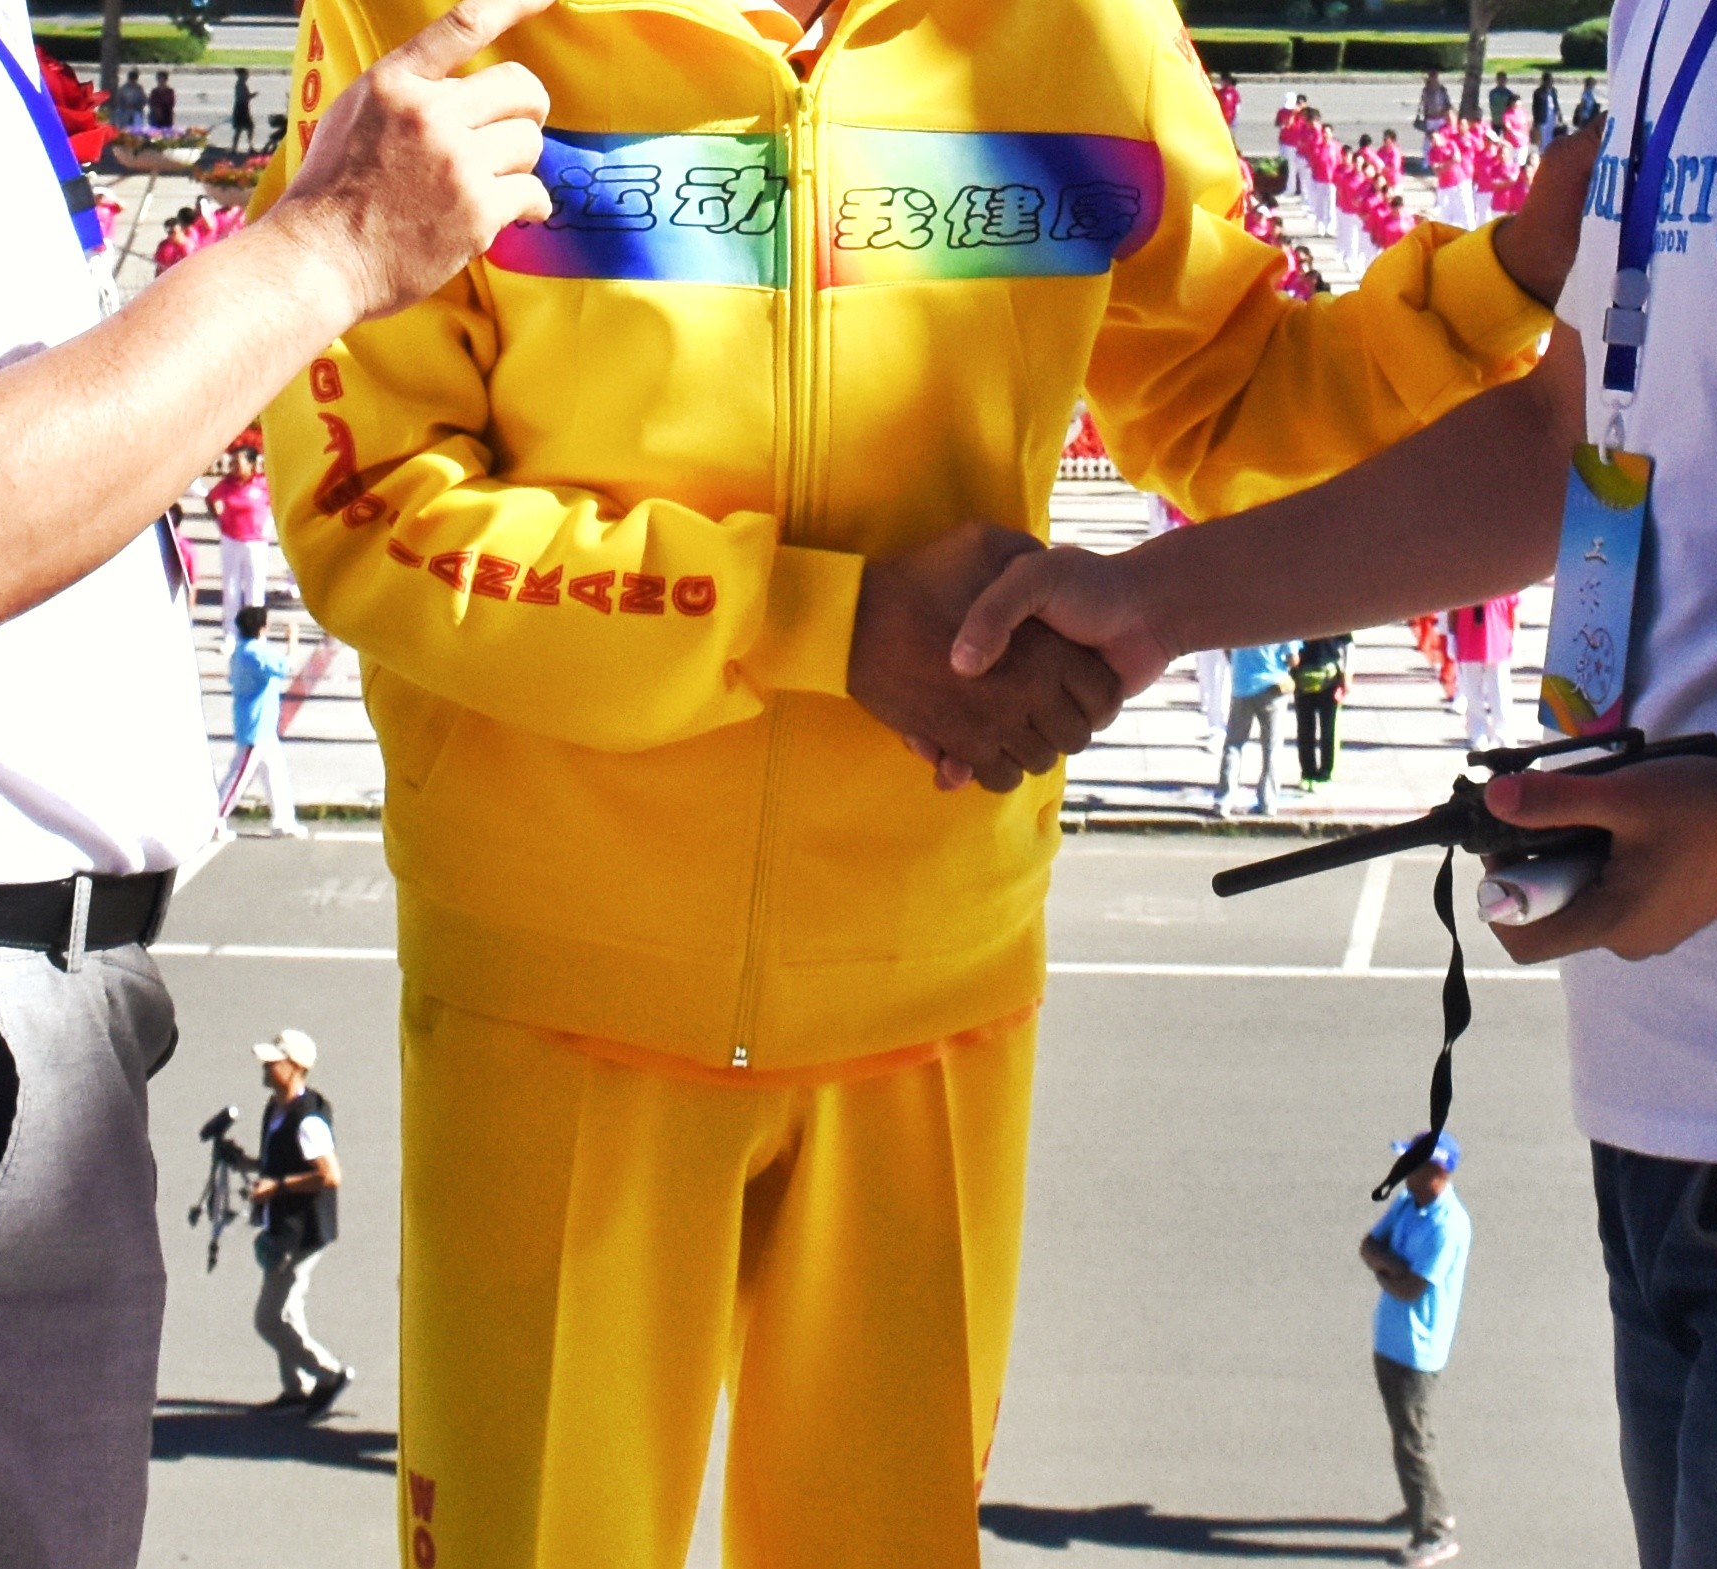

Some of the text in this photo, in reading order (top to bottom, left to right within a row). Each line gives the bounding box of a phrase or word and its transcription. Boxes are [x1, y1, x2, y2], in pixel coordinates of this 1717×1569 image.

[517, 163, 1141, 250] 运动 我健康
